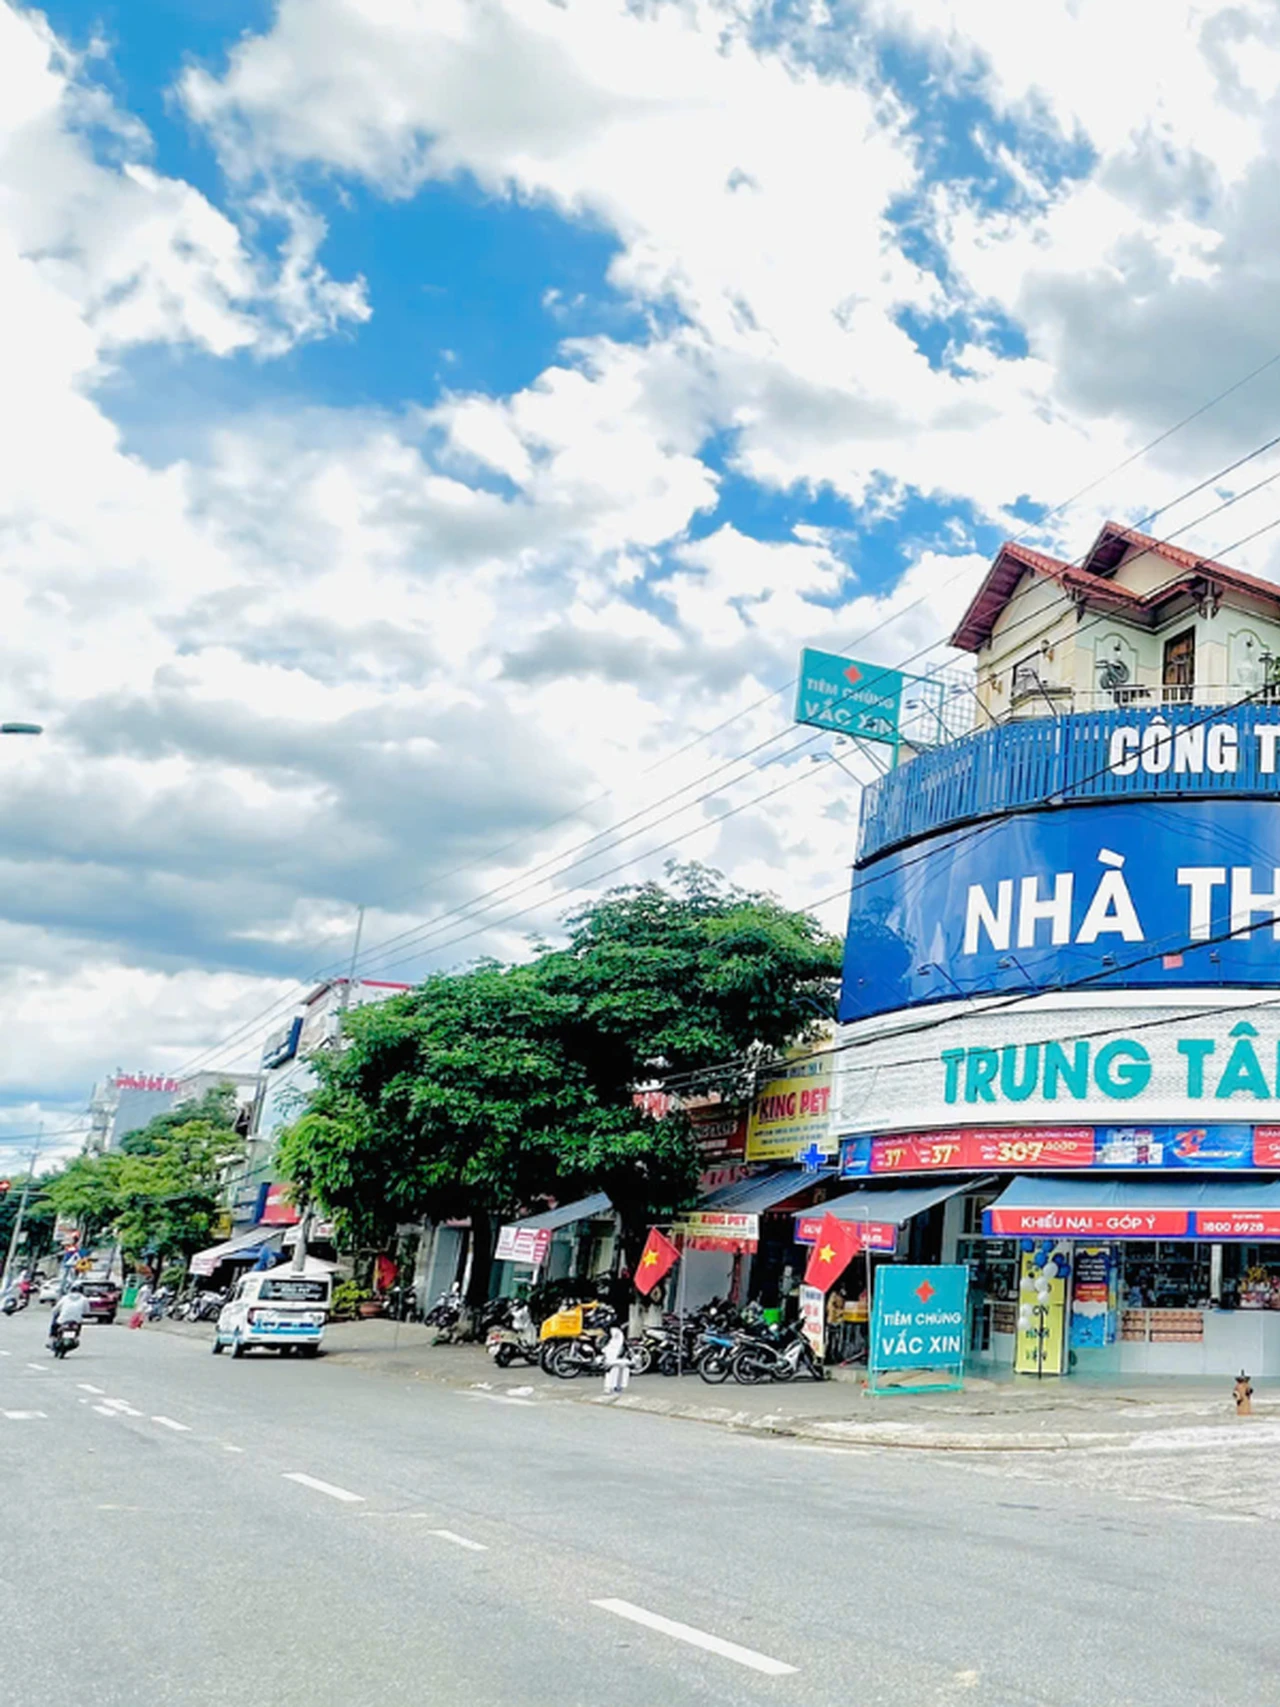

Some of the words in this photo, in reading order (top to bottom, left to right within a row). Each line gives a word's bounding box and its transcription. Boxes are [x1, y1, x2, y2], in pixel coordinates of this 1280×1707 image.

[1109, 715, 1238, 776] CÔNG
[963, 848, 1146, 956] NHÀ
[940, 1037, 1153, 1105] TRUNG
[758, 1091, 797, 1121] KING
[800, 1086, 831, 1115] PET
[1021, 1212, 1063, 1229] KHIẾU
[1067, 1217, 1093, 1232] NẠI
[1106, 1214, 1142, 1229] GÓP
[1146, 1213, 1157, 1229] Ý
[1203, 1221, 1231, 1232] 1800
[1234, 1221, 1264, 1232] 6928
[883, 1310, 912, 1326] TIÊM
[915, 1308, 963, 1325] CHỦNG
[882, 1329, 923, 1355] VẮC
[928, 1335, 960, 1353] XIN
